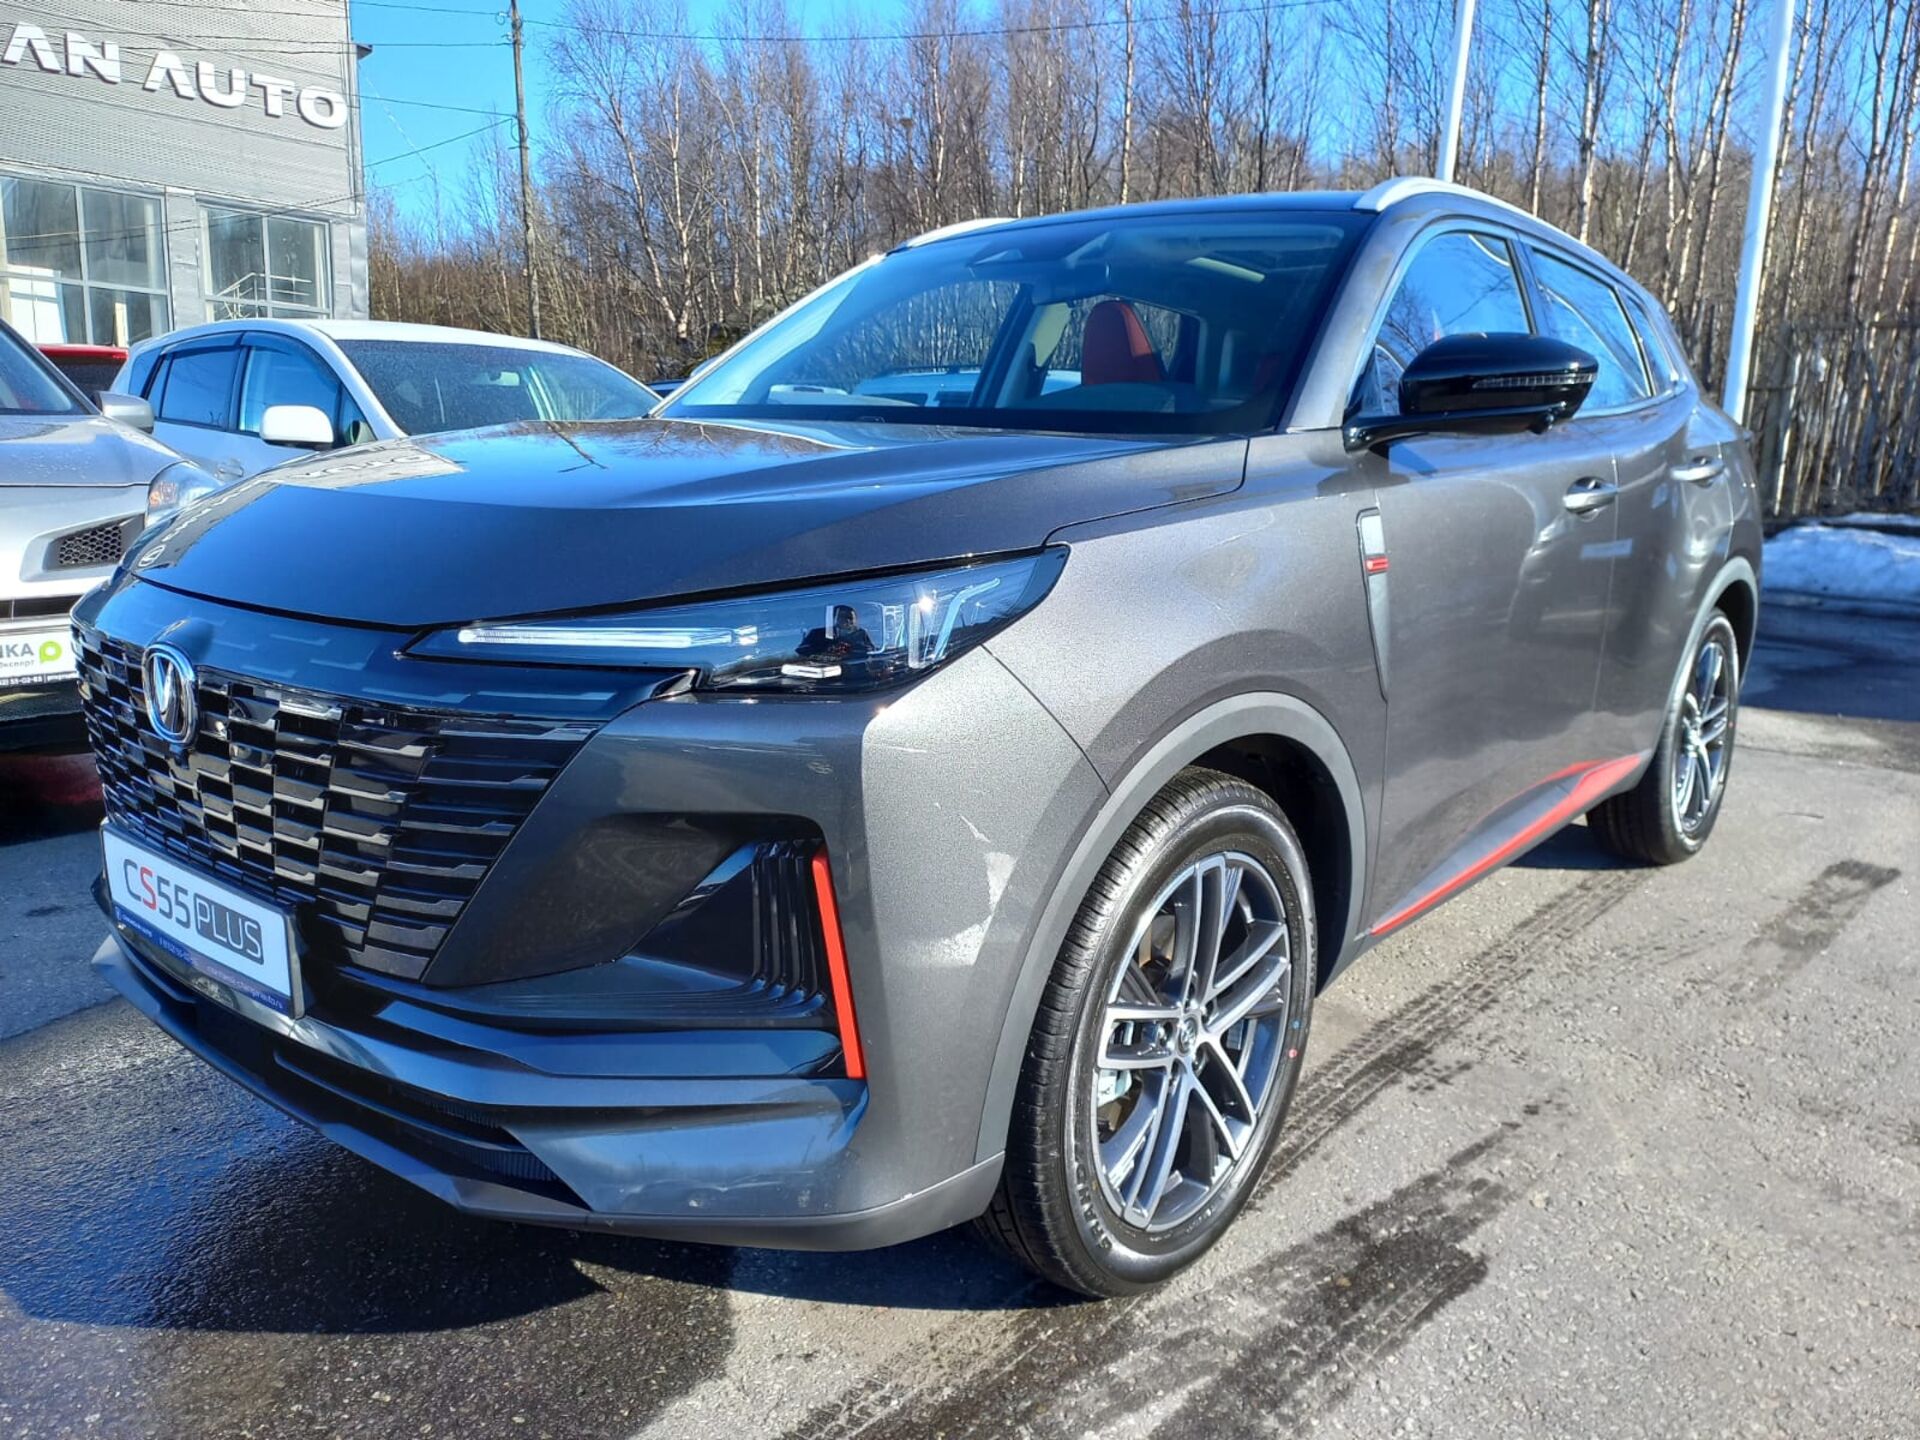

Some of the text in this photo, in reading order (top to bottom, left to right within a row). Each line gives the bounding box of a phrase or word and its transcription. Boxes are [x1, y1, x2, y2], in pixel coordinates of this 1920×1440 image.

[143, 51, 348, 129] AUTO
[123, 858, 191, 930] CS55
[196, 894, 263, 961] PLUS
